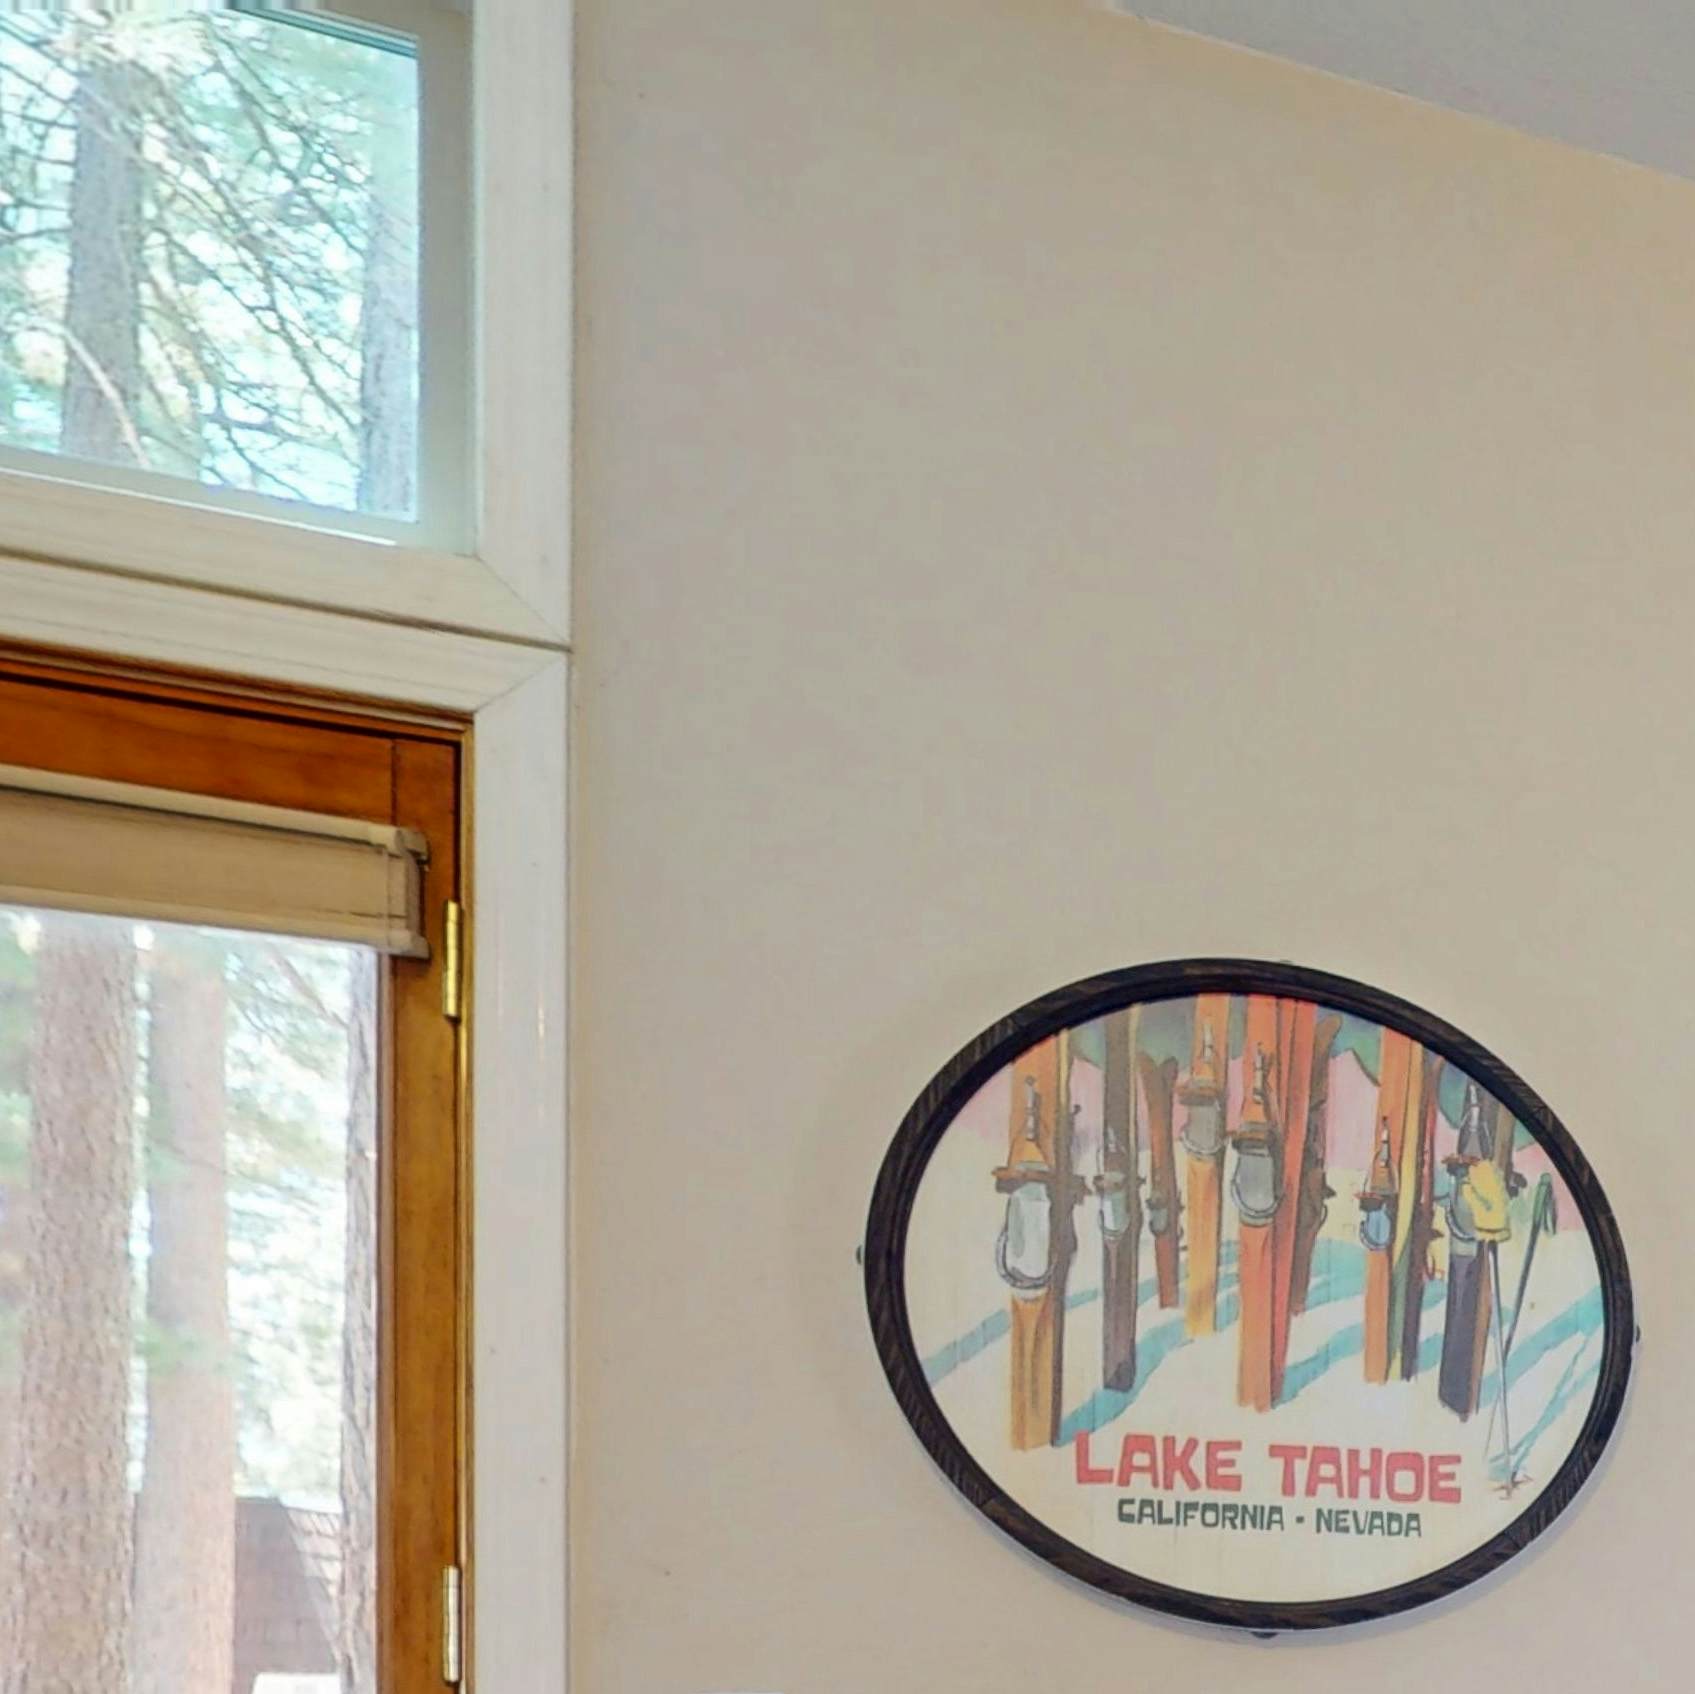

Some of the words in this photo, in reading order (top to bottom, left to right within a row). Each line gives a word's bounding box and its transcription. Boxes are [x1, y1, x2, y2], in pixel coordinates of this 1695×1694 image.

[1076, 1431, 1242, 1491] LAKE
[1269, 1444, 1462, 1504] TAHOE
[1117, 1498, 1284, 1531] CALIFORNIA
[1316, 1508, 1422, 1537] NEVADA
